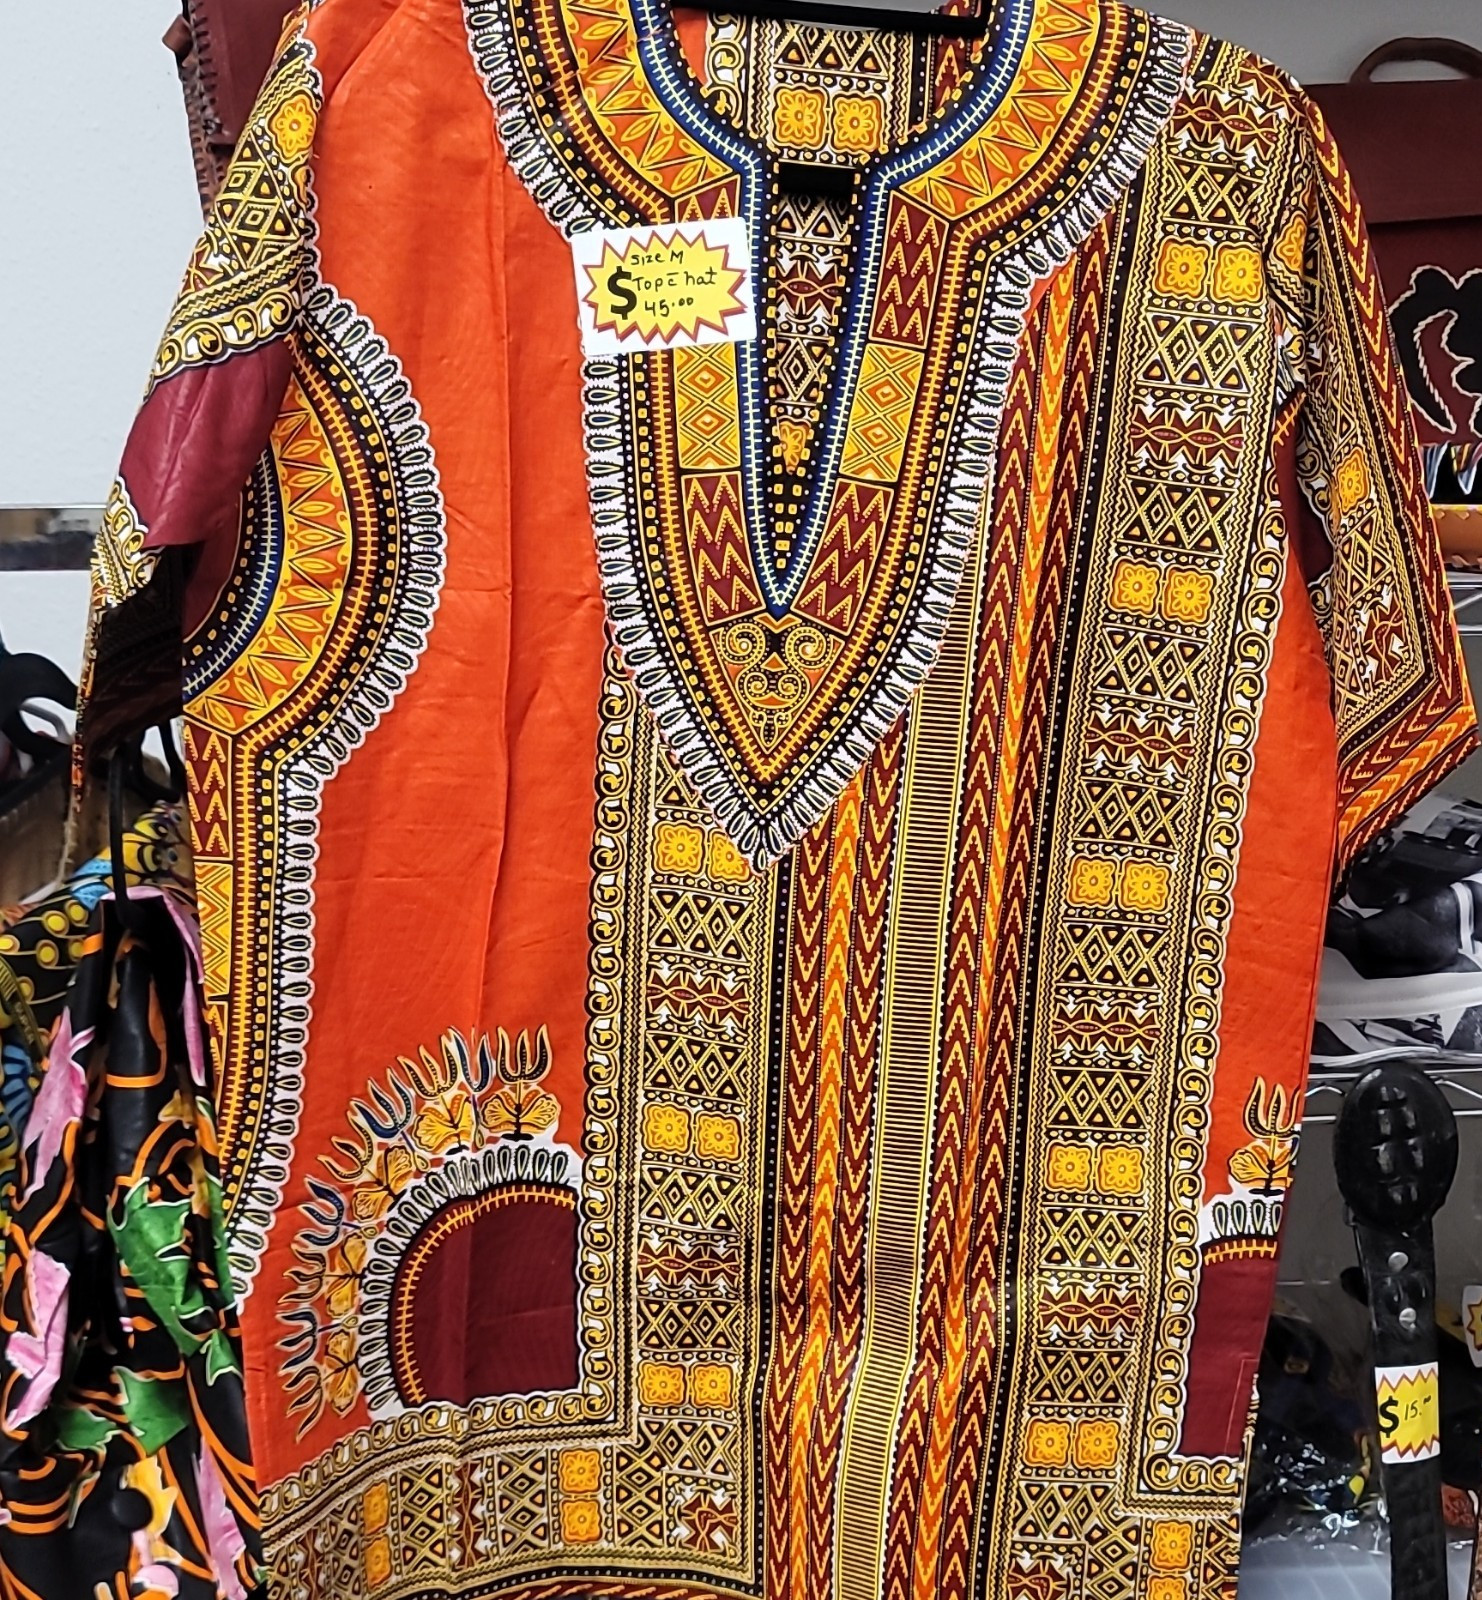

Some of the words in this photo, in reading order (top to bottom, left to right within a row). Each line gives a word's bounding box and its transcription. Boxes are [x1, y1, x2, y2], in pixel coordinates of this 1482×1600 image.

[670, 250, 684, 264] M
[684, 266, 717, 286] hat
[644, 297, 694, 317] 45.00
